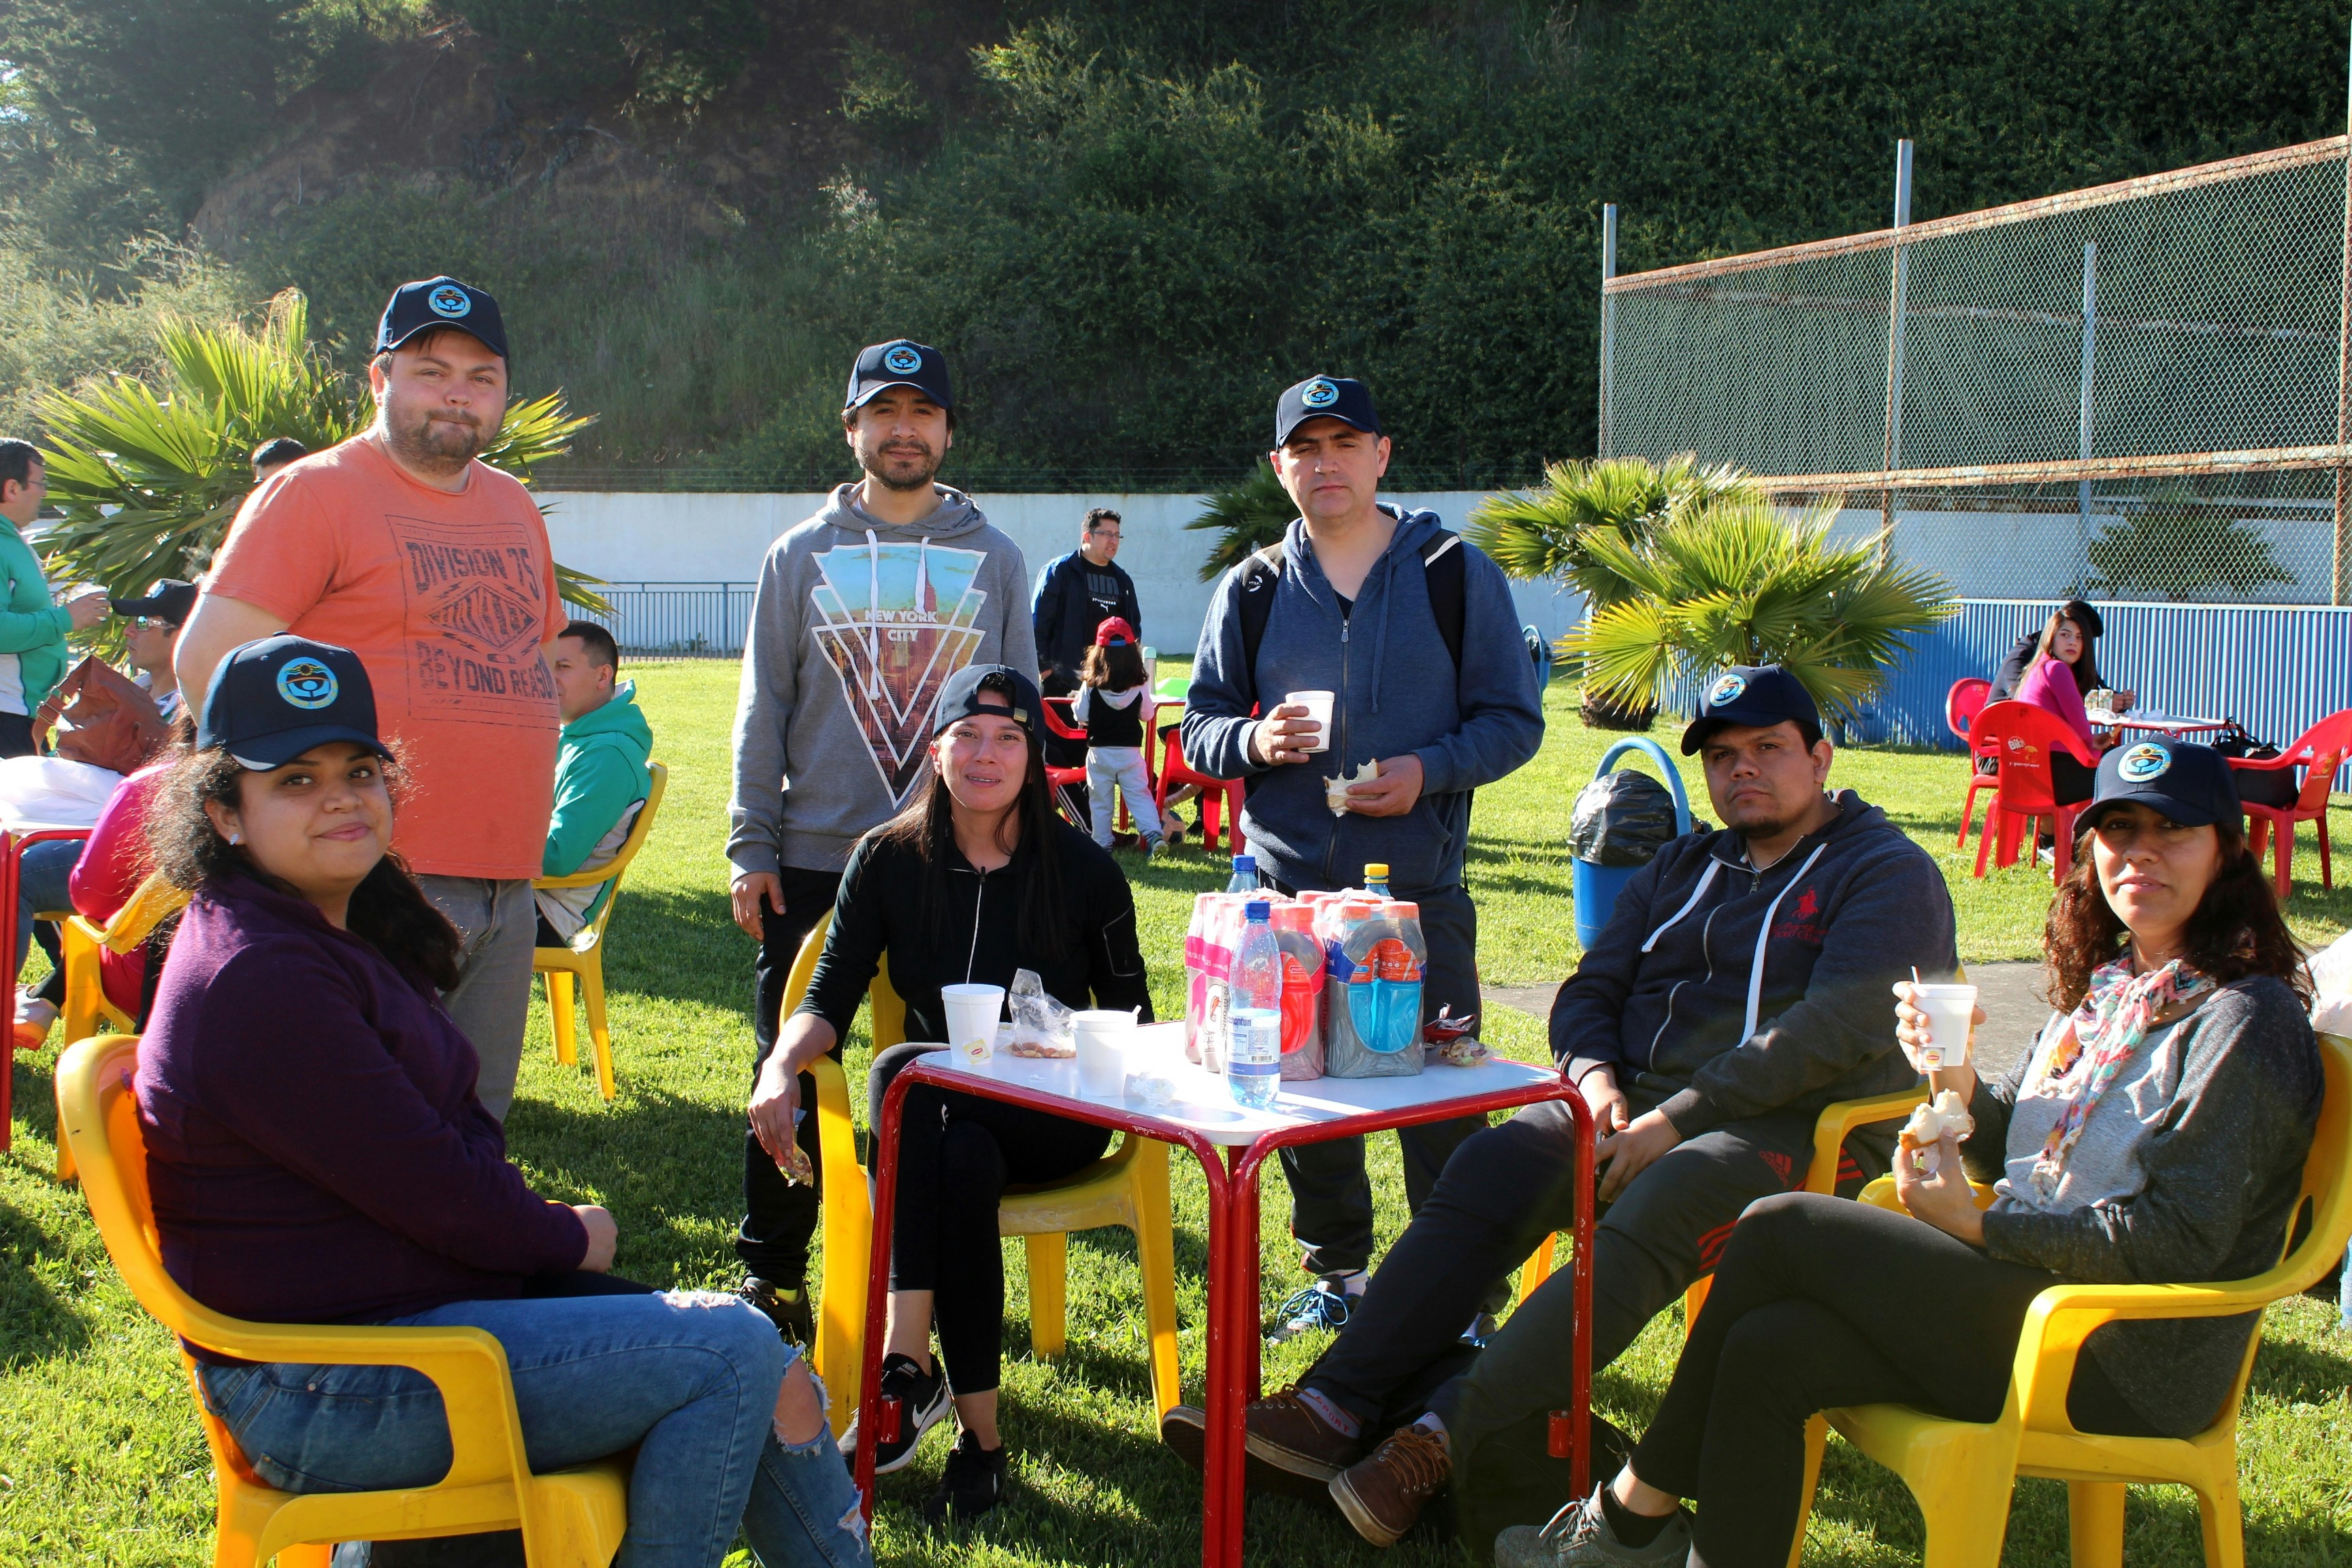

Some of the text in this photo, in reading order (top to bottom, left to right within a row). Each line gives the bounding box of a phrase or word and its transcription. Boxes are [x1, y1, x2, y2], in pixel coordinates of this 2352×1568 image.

[405, 542, 540, 602] DIVISION 75
[865, 609, 938, 623] NEW YORK
[887, 629, 919, 642] CITY
[416, 640, 506, 695] BEYOND
[902, 1362, 918, 1374] NIKE
